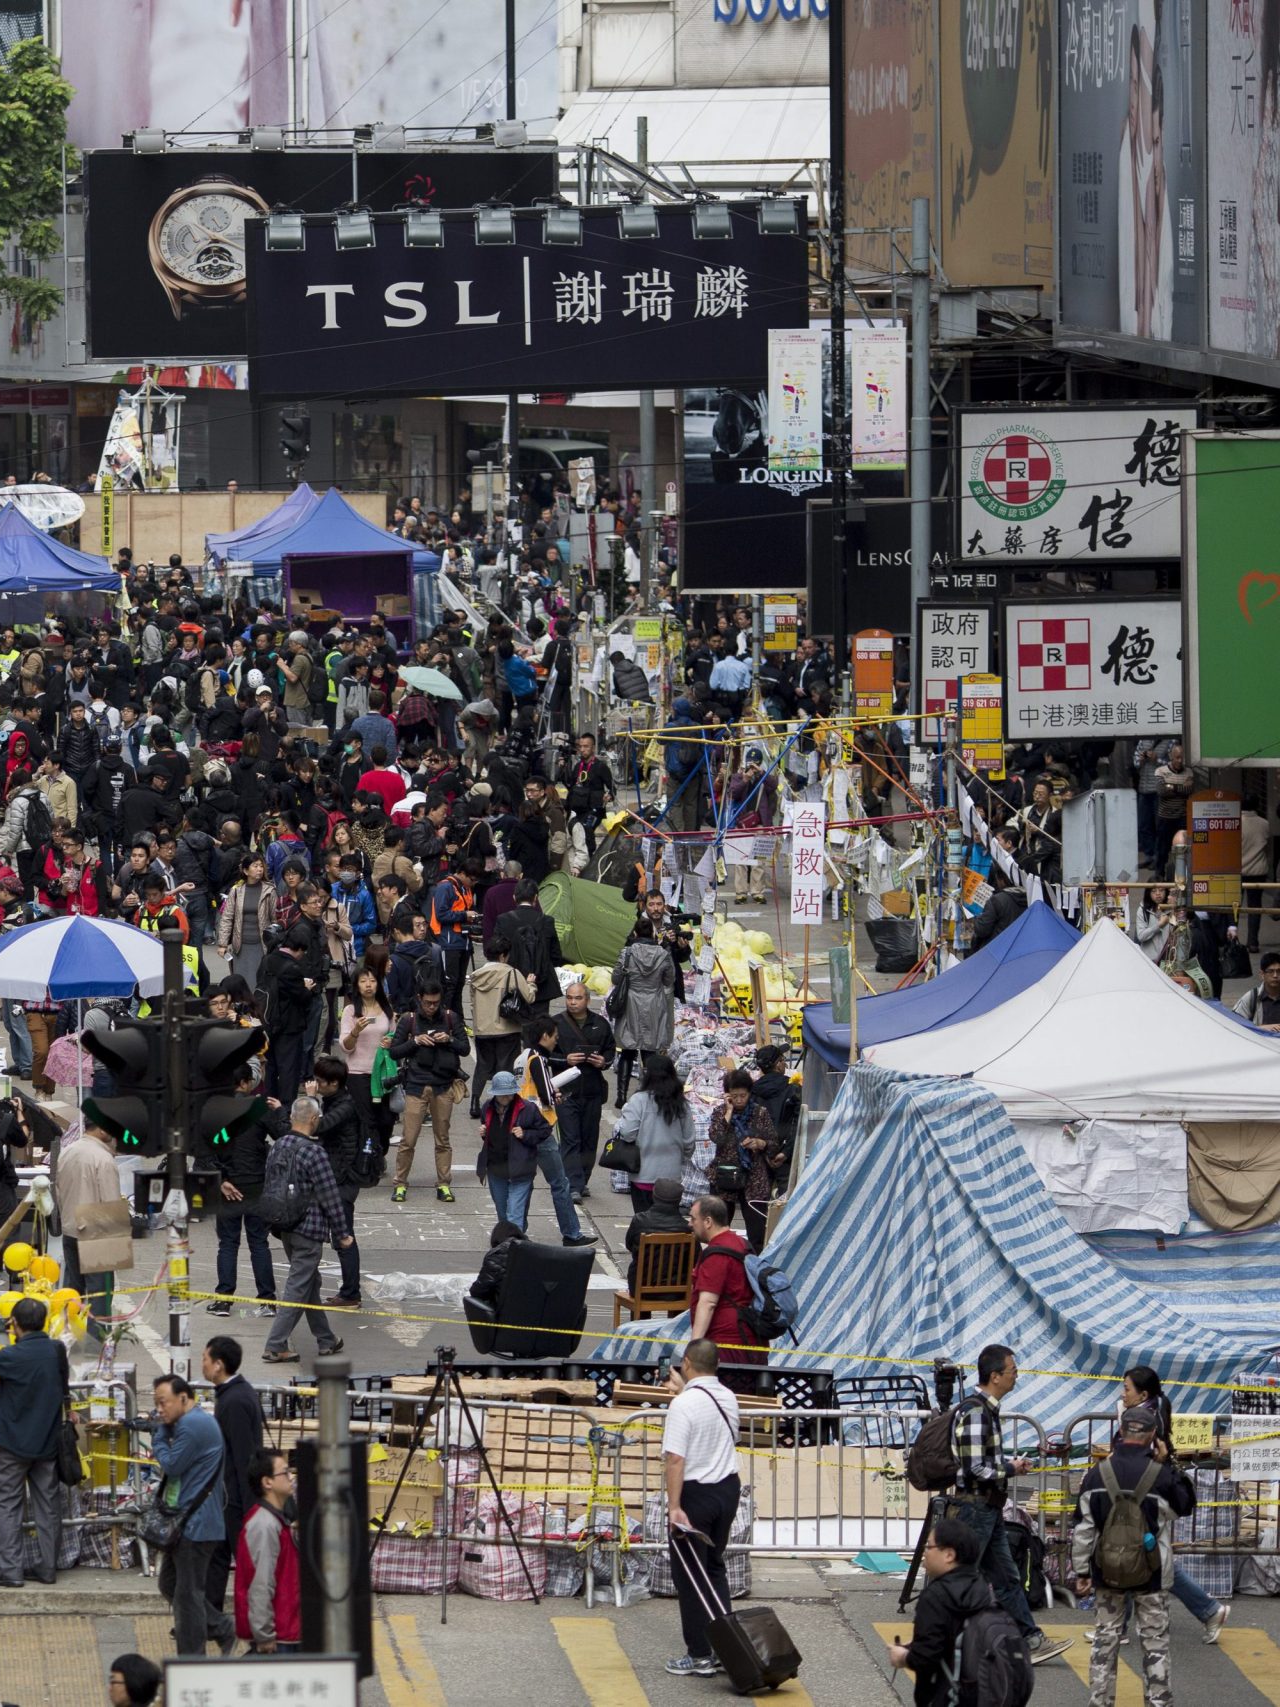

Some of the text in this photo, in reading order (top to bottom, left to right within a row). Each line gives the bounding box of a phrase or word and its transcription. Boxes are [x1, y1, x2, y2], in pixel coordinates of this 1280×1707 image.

[305, 281, 501, 329] TSL
[552, 265, 750, 325] 謝瑞麟
[967, 525, 1063, 556] 大藥房
[930, 612, 980, 636] 政府
[930, 645, 979, 669] 認可
[962, 698, 1001, 708] 619 621 671
[1019, 701, 1139, 729] 中港澳連鎖
[962, 749, 975, 758] 619
[1209, 819, 1223, 830] 601
[791, 808, 824, 918] 急救站
[1193, 882, 1208, 892] 690
